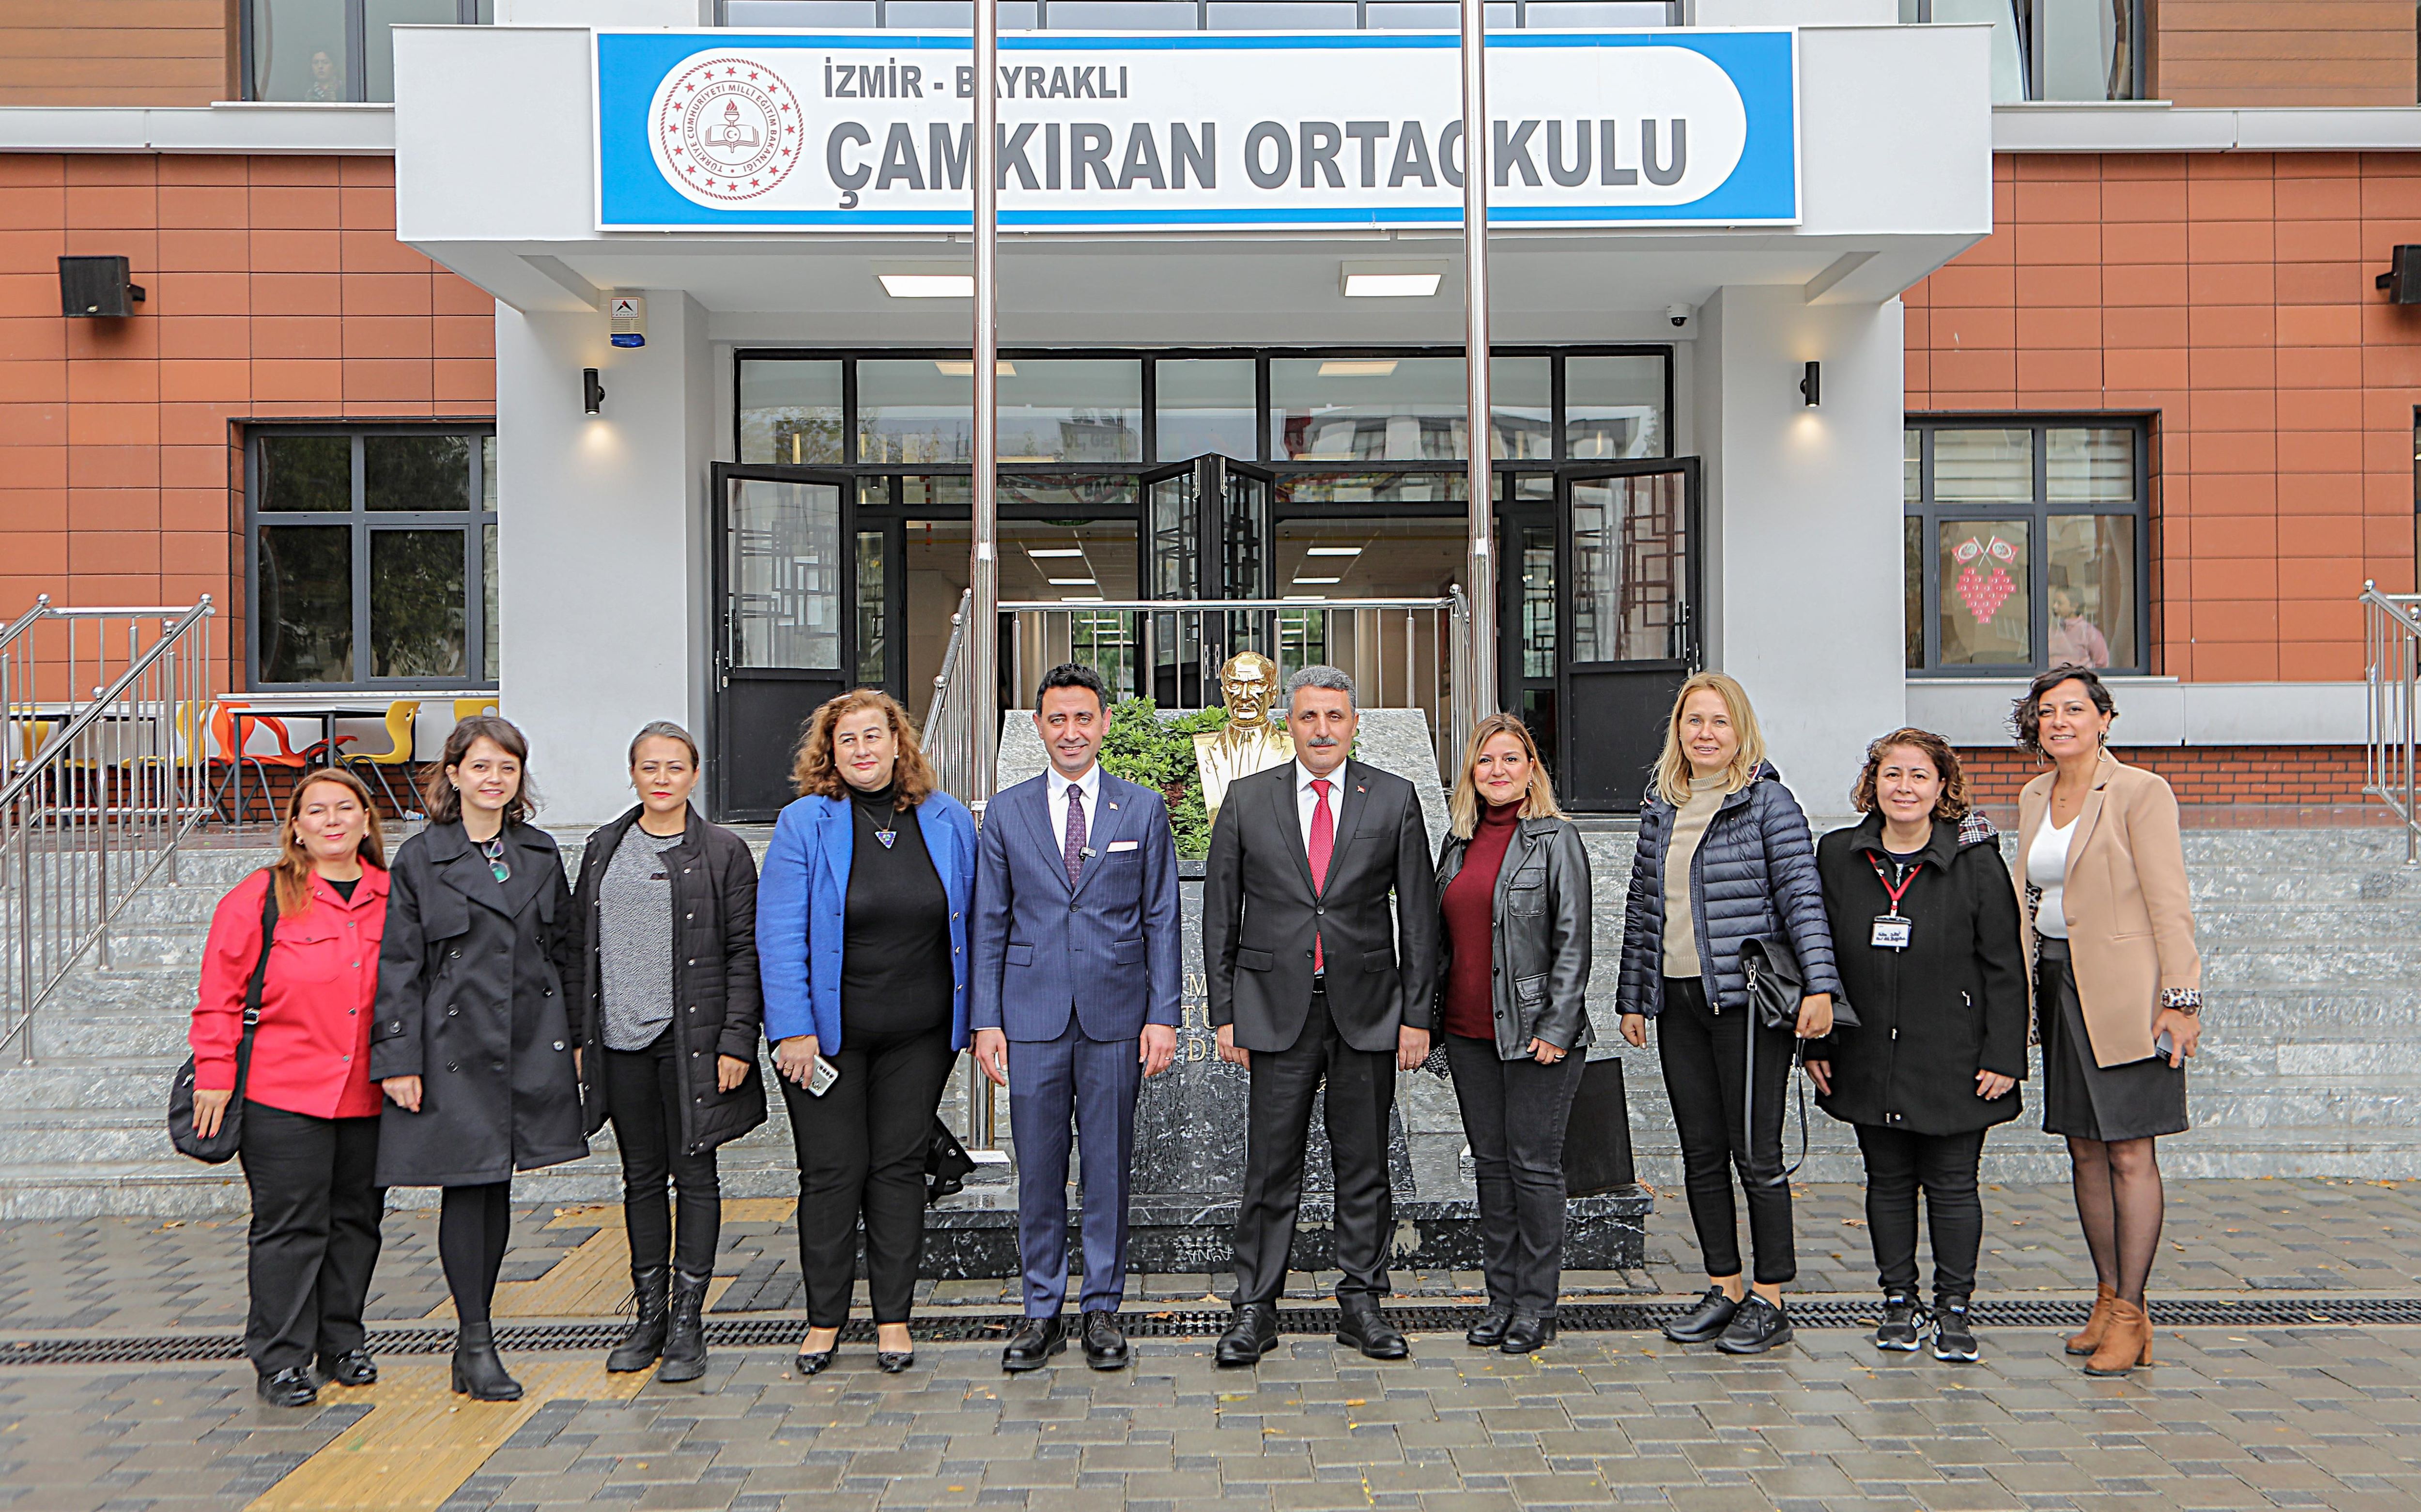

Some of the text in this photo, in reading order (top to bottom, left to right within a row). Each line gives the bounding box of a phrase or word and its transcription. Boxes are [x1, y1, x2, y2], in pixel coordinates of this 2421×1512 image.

[824, 57, 924, 98] İZMİR
[956, 66, 1127, 99] BYRAKLI
[687, 84, 725, 139] CUMHURİYETİ
[756, 95, 777, 126] EĞİTİM
[690, 141, 723, 172] TÜRKİYE
[743, 130, 777, 172] BAKANLIĞI
[826, 121, 1216, 209] ÇAMKIRAN
